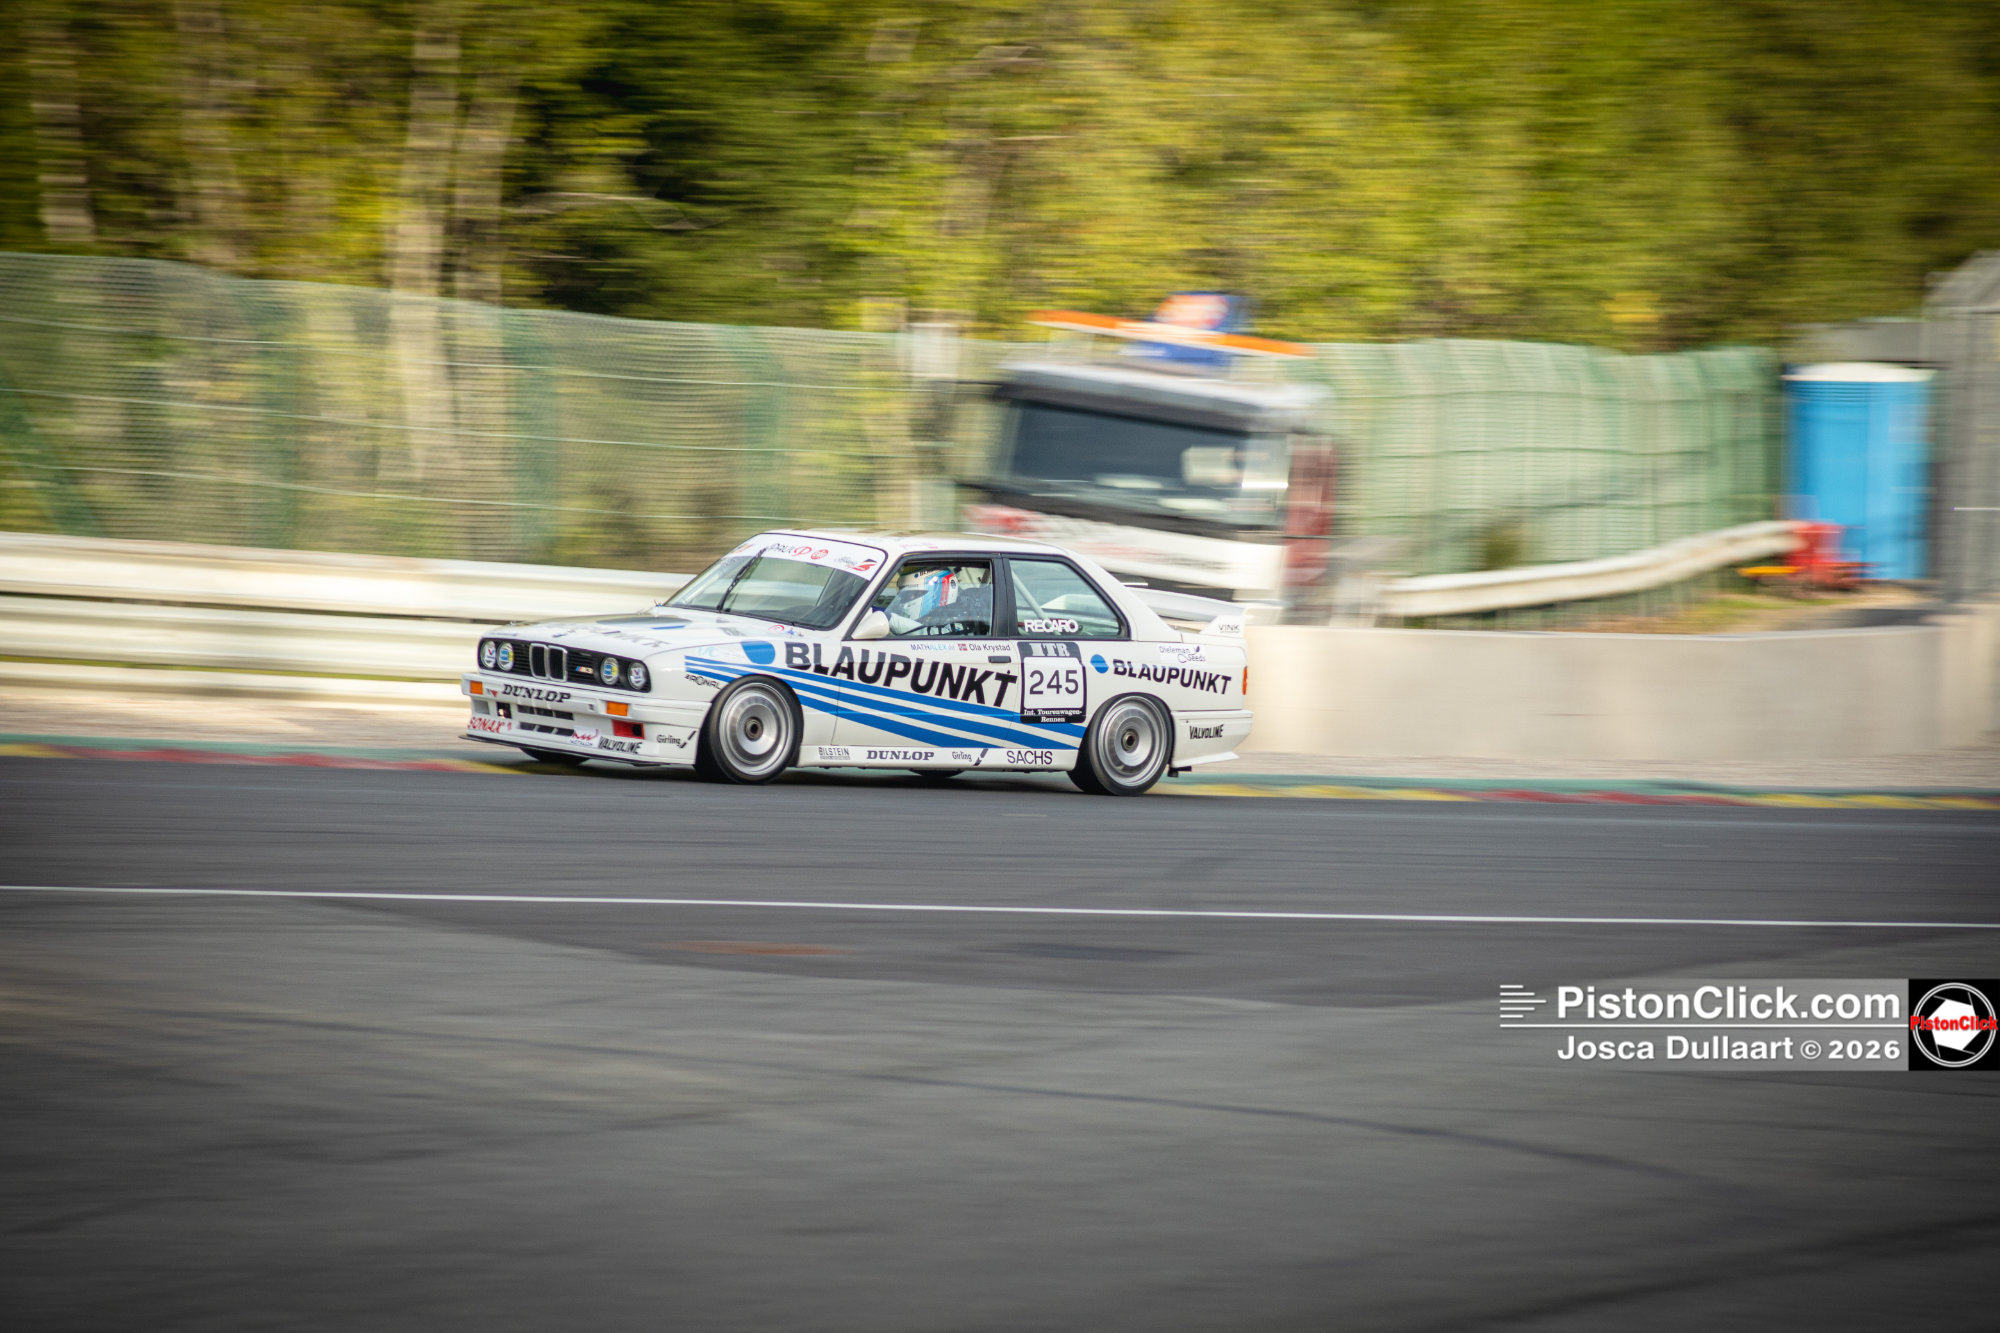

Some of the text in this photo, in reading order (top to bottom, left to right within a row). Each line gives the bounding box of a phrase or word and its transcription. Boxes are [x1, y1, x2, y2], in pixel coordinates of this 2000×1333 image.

[1023, 618, 1079, 633] RECARO
[1218, 623, 1240, 632] VINK
[1028, 642, 1071, 657] ITR
[784, 641, 1018, 708] BLAUPUNKT
[1029, 669, 1079, 695] 245
[1112, 659, 1232, 695] BLAUPUNKT
[502, 684, 571, 703] DUNLOP
[1037, 709, 1083, 717] Tourenwagen-
[1189, 724, 1224, 740] VALVOLINE
[599, 736, 642, 755] VALVOLINE
[656, 734, 681, 748] Girling
[818, 746, 850, 756] BILSTEIN
[866, 749, 935, 761] DUNLOP
[952, 751, 972, 762] Girling
[1006, 750, 1053, 765] SACHS
